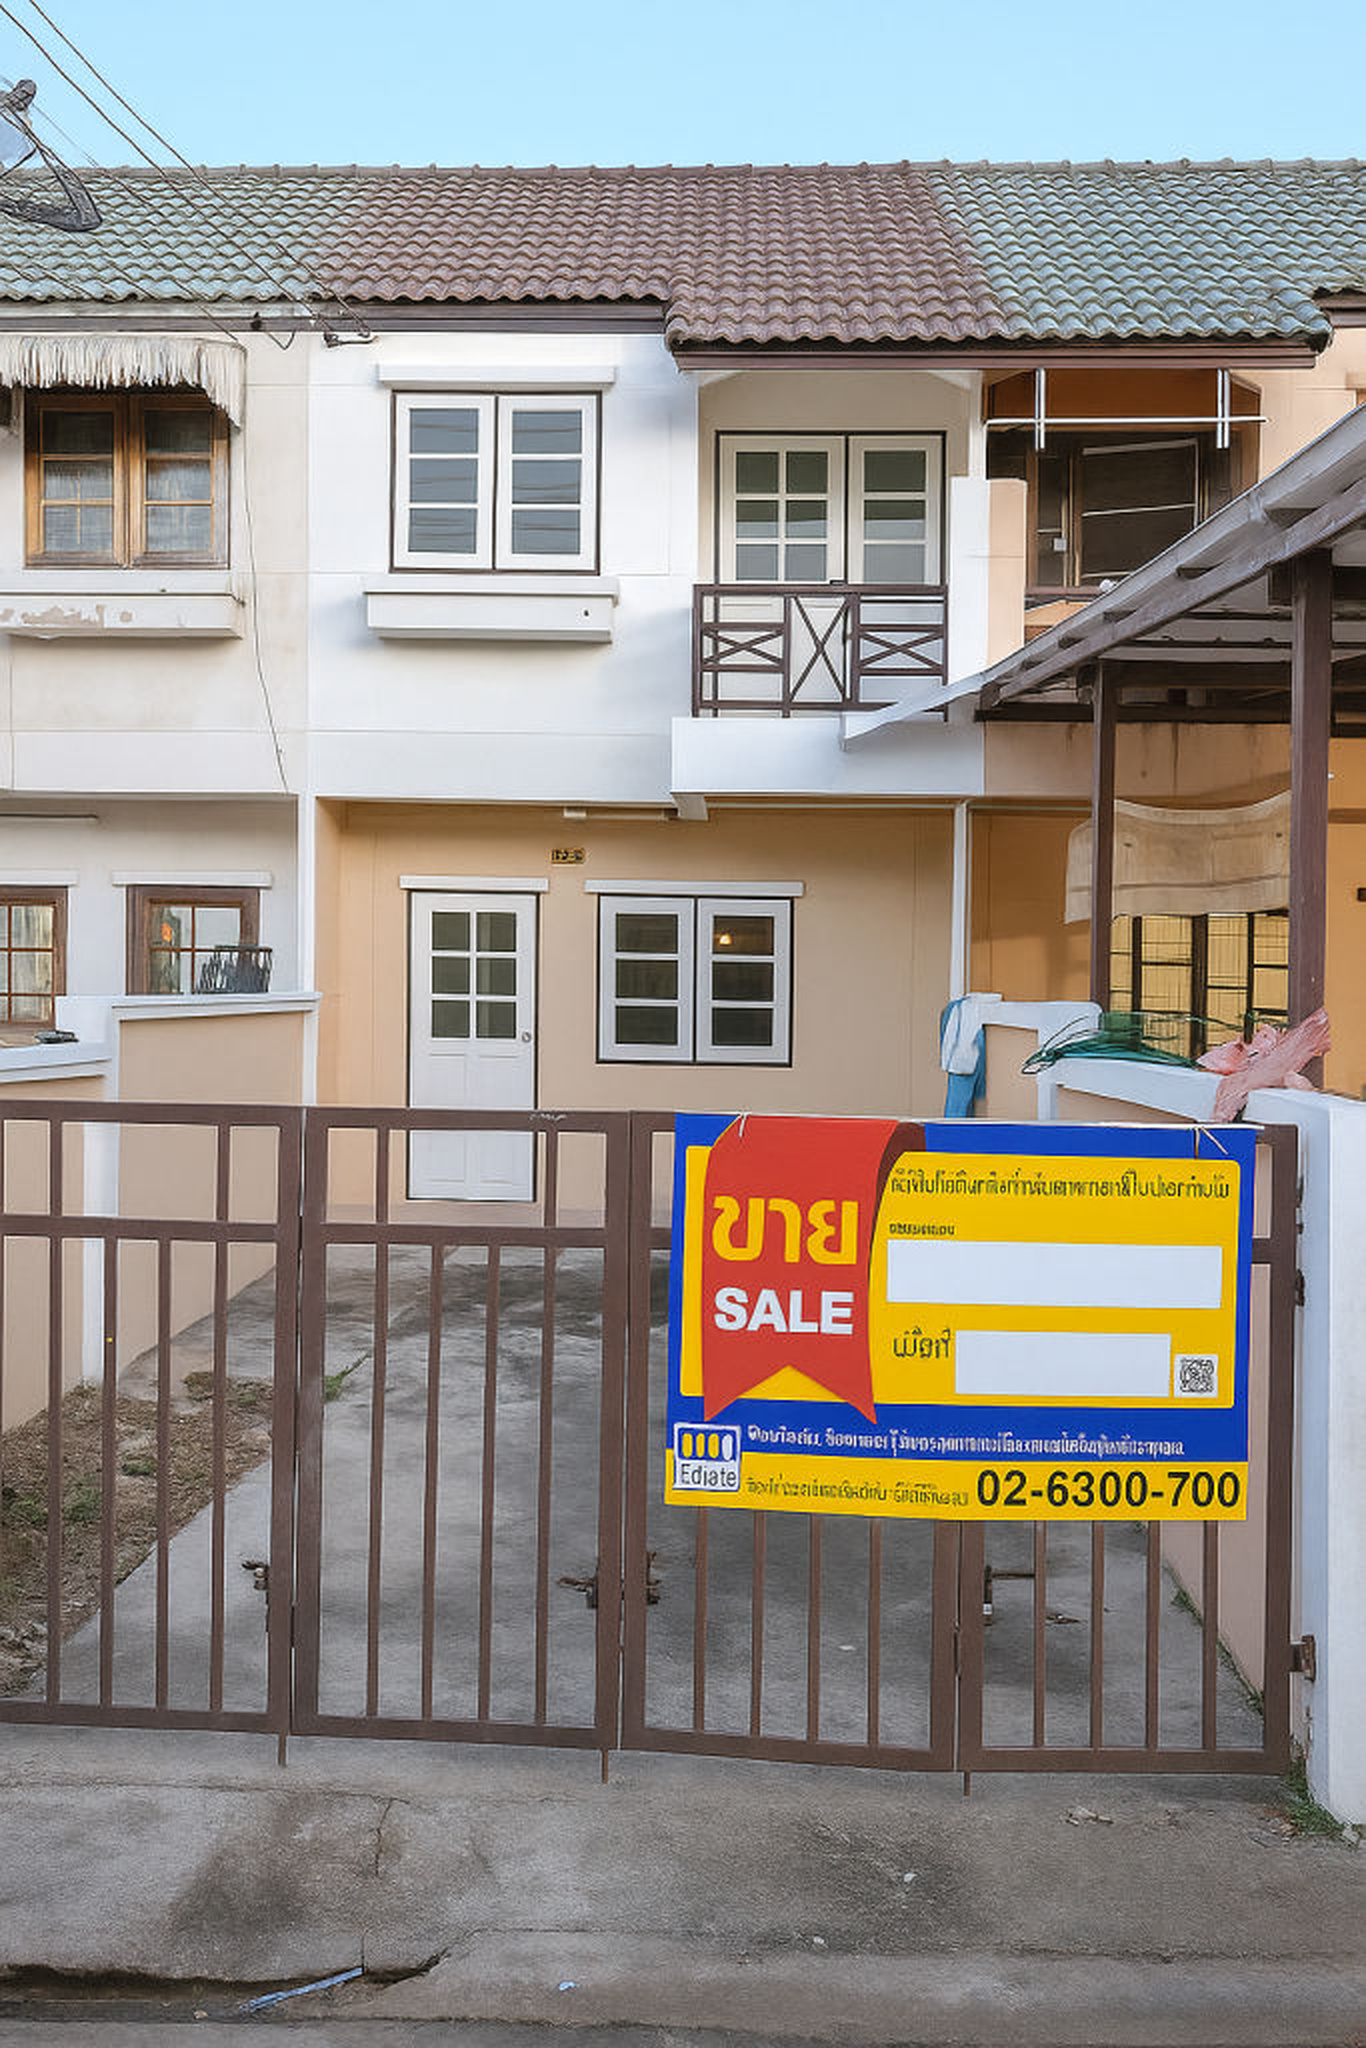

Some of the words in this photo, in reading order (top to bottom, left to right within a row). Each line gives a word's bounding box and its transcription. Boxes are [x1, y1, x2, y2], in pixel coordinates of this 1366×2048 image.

[712, 1196, 859, 1265] ขาย
[714, 1287, 854, 1335] SALE
[977, 1469, 1240, 1508] 02-6300-700
